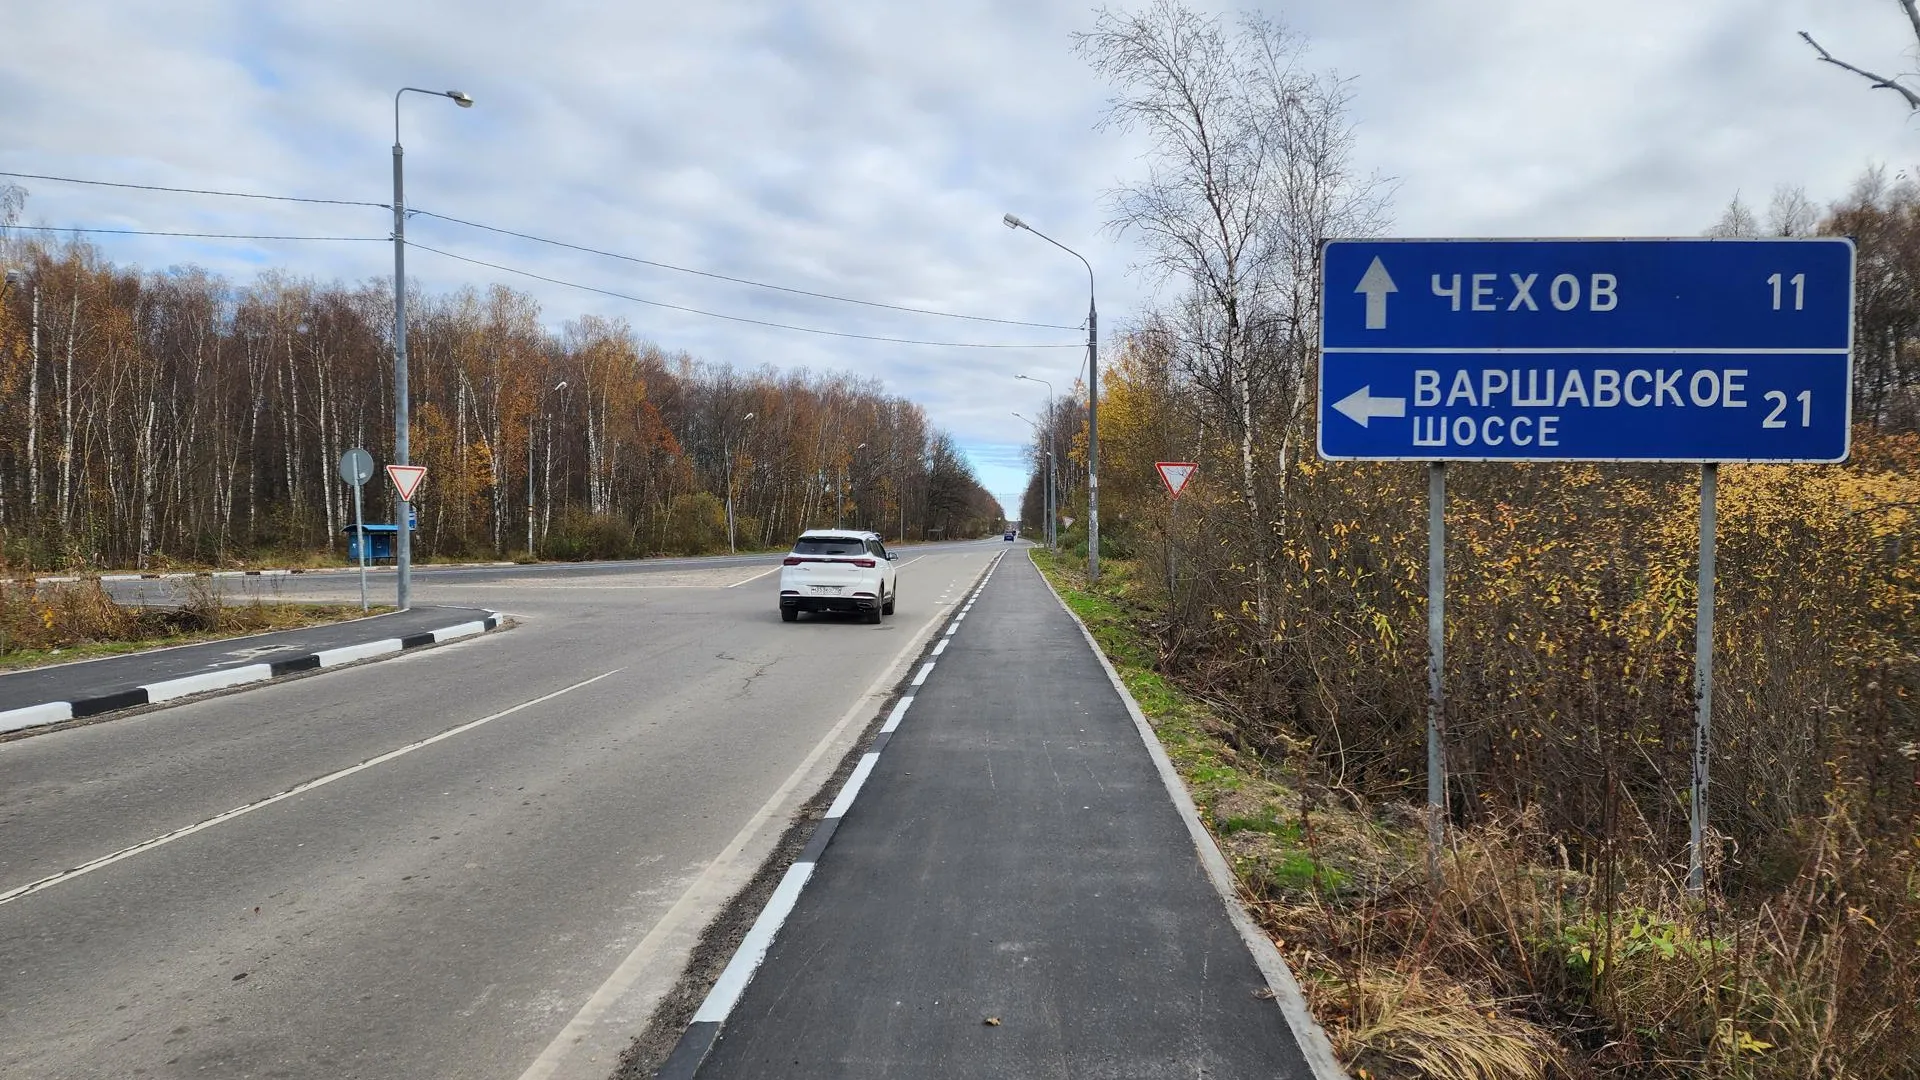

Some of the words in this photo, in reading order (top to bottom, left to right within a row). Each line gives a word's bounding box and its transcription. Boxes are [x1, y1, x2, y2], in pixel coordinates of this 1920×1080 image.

[1431, 273, 1618, 312] ЧЕХОВ
[1766, 273, 1805, 310] 11
[1414, 369, 1748, 408] ВАРШАВСКОЕ
[1762, 390, 1811, 429] 21
[1412, 416, 1560, 447] ШОССЕ
